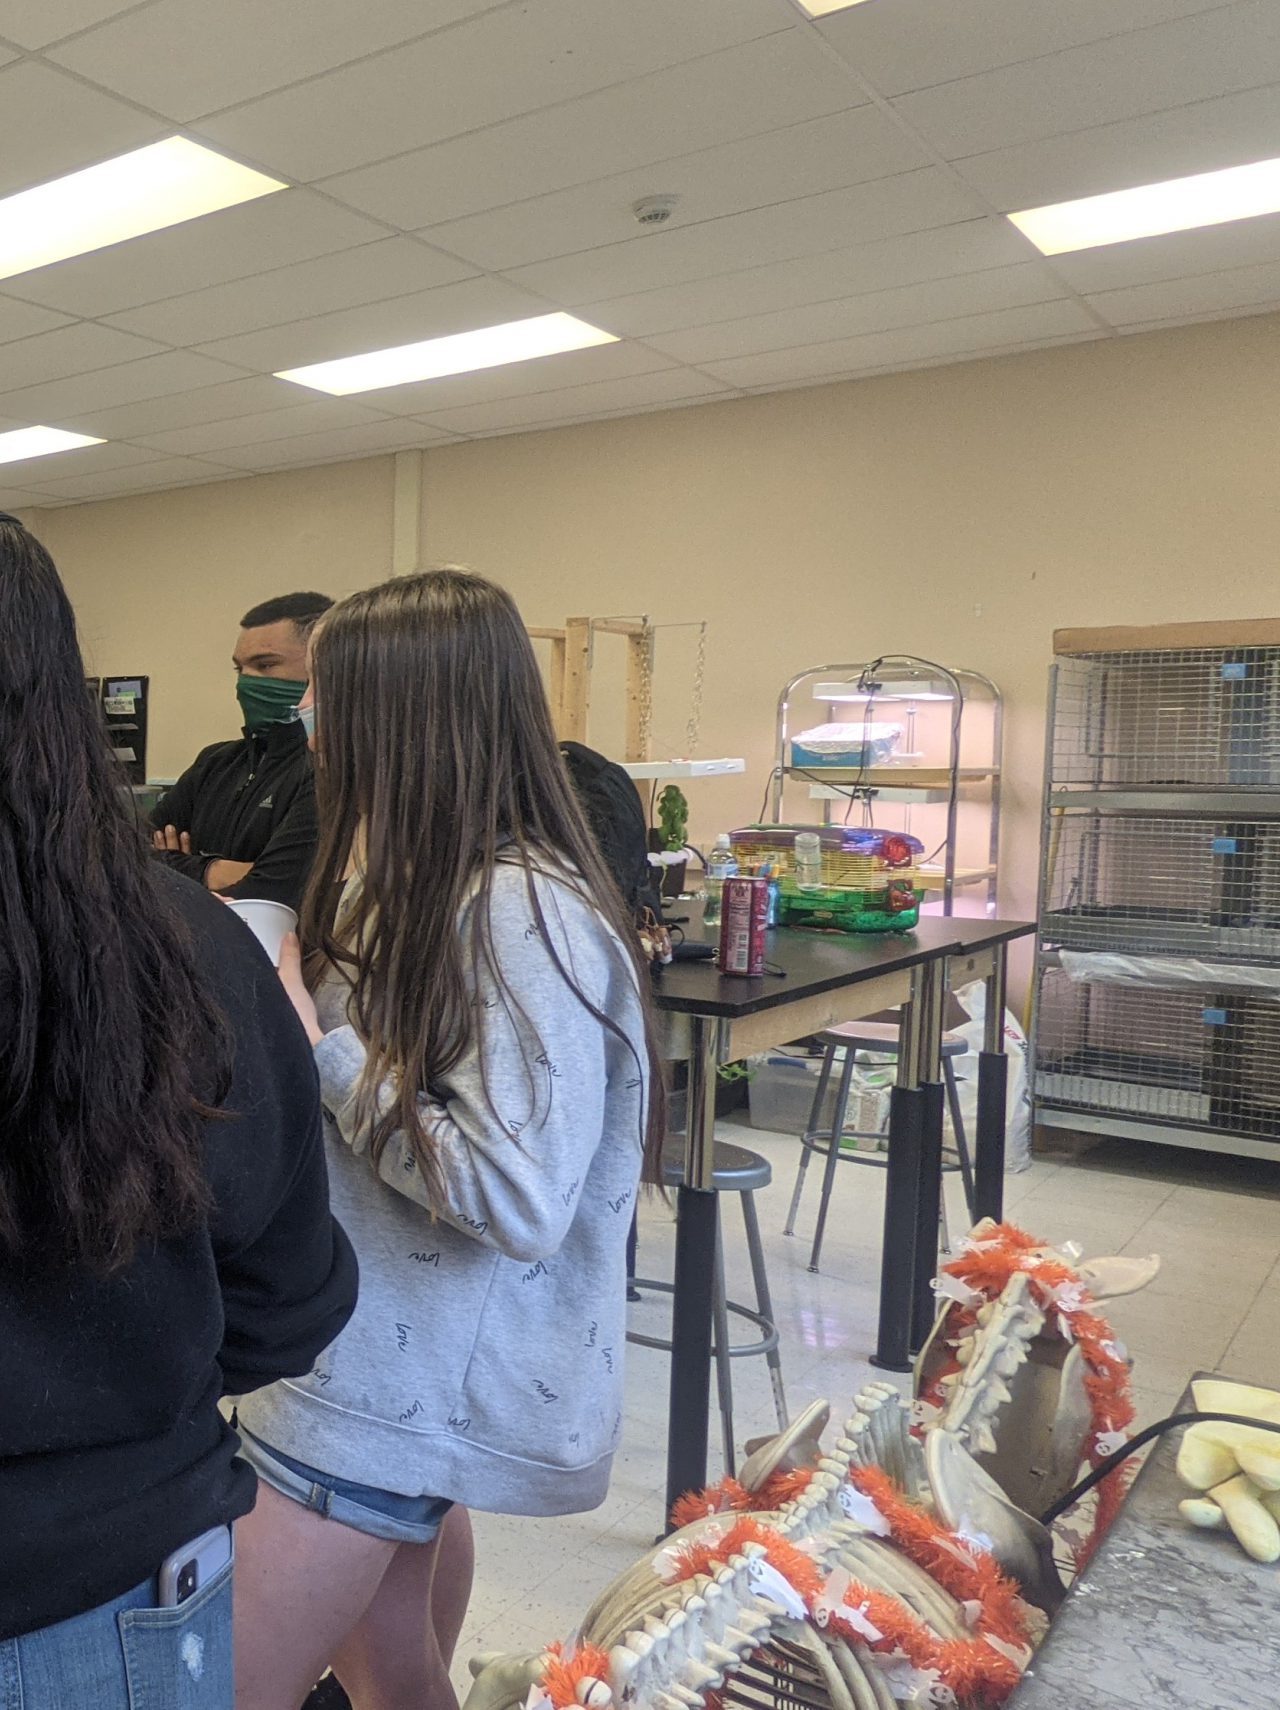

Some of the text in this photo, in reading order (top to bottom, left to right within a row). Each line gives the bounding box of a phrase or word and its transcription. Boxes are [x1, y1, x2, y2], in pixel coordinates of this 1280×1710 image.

[562, 1176, 580, 1207] love
[608, 1187, 632, 1214] love
[457, 1214, 488, 1236] love
[408, 1252, 440, 1267] love
[522, 1260, 549, 1285] love
[395, 1322, 412, 1352] love
[584, 1321, 598, 1347] love
[311, 1368, 332, 1386] lov
[532, 1379, 559, 1404] love
[399, 1400, 425, 1422] love
